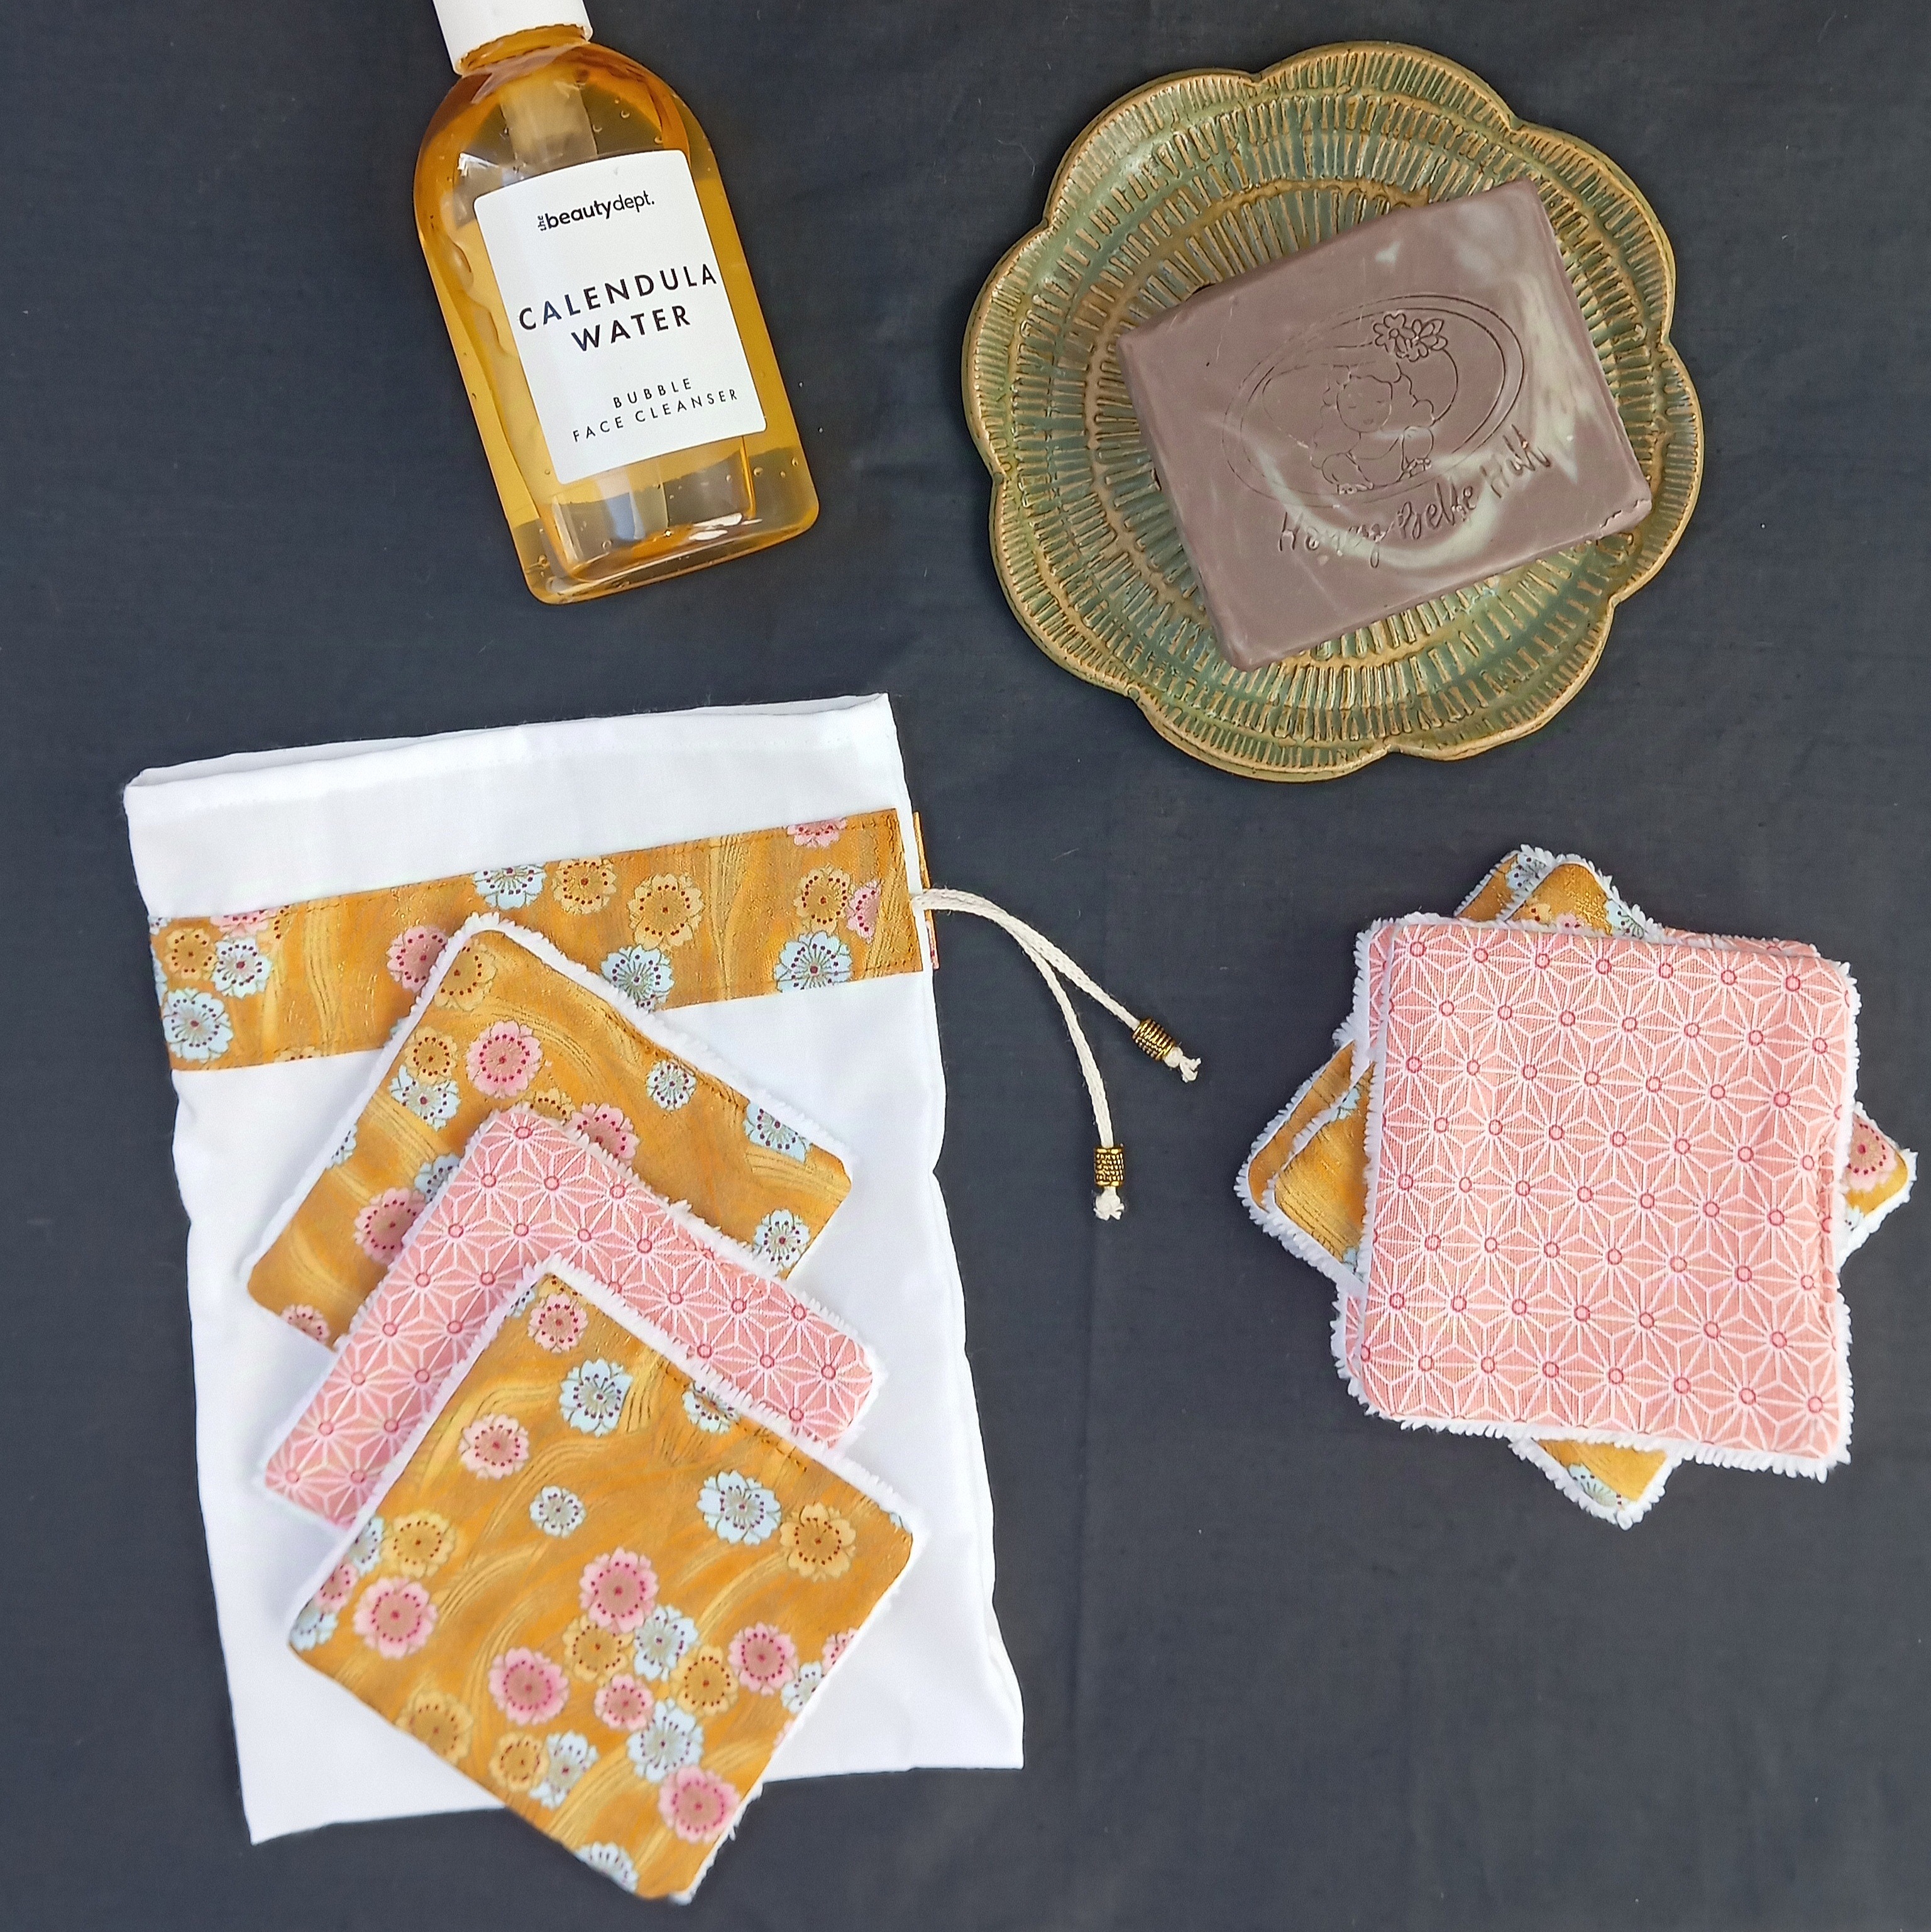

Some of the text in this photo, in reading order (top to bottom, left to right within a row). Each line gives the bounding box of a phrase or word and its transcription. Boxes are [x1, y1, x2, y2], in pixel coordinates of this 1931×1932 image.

[519, 263, 717, 330] CALENDULA
[571, 305, 691, 351] WATER
[573, 389, 737, 443] FACE CLEANSER
[613, 378, 691, 409] BUBBLE
